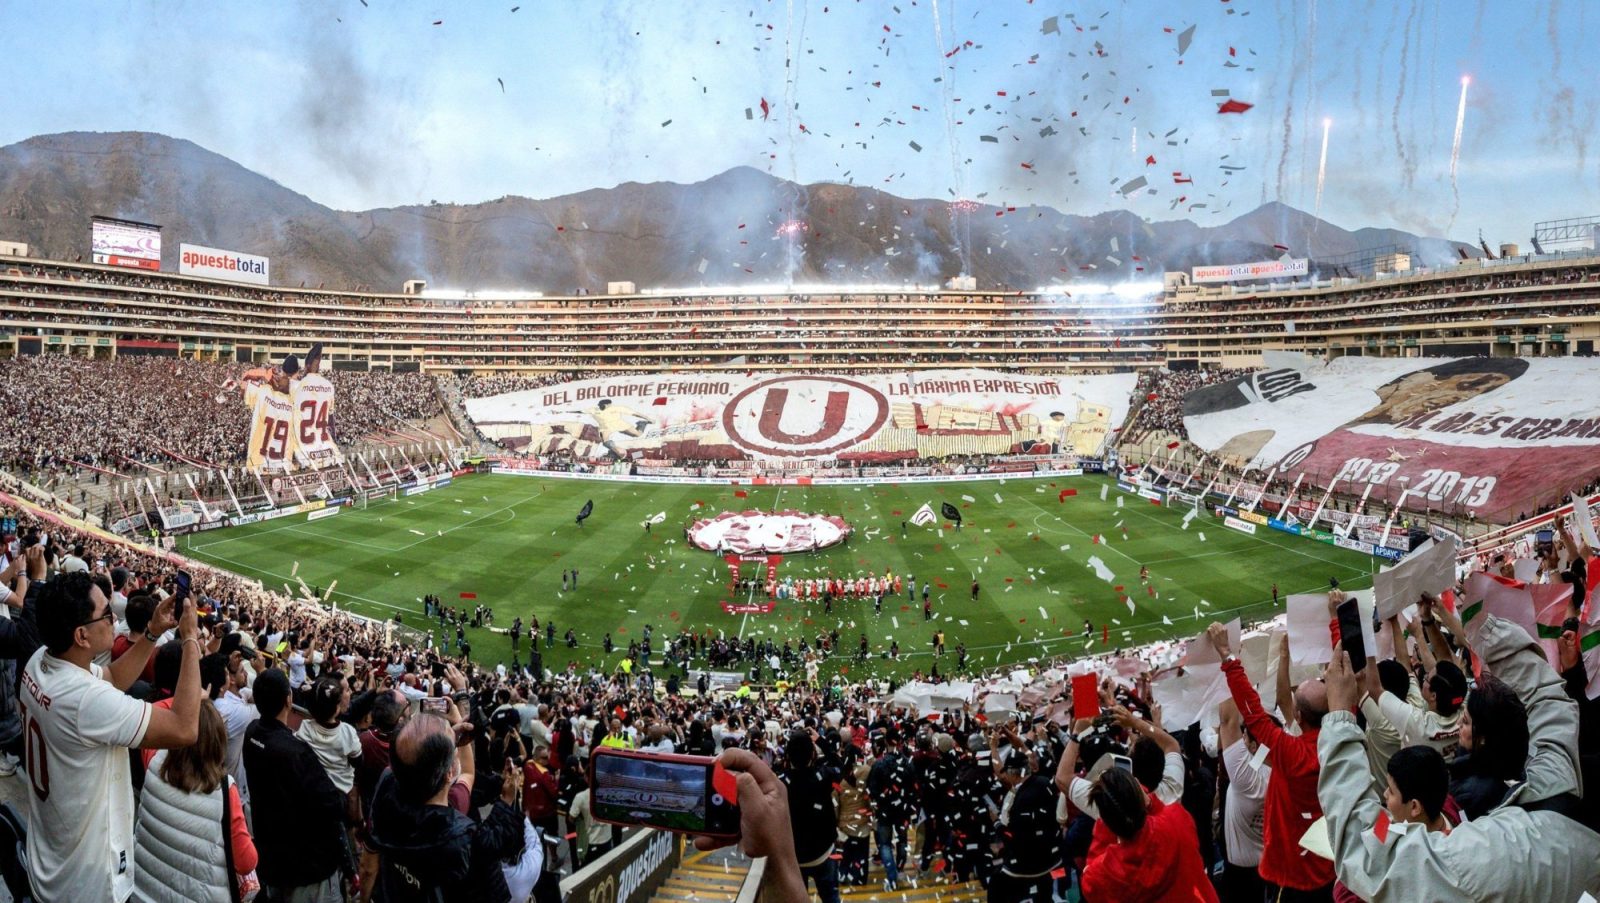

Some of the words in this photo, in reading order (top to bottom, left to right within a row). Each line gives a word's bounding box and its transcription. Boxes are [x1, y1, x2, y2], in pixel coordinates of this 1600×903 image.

[183, 252, 266, 275] apuestatotal
[543, 391, 572, 407] DEL
[888, 382, 910, 396] LA
[300, 400, 329, 444] 24
[758, 387, 850, 445] U
[259, 416, 289, 460] 19
[1406, 468, 1497, 507] 2013
